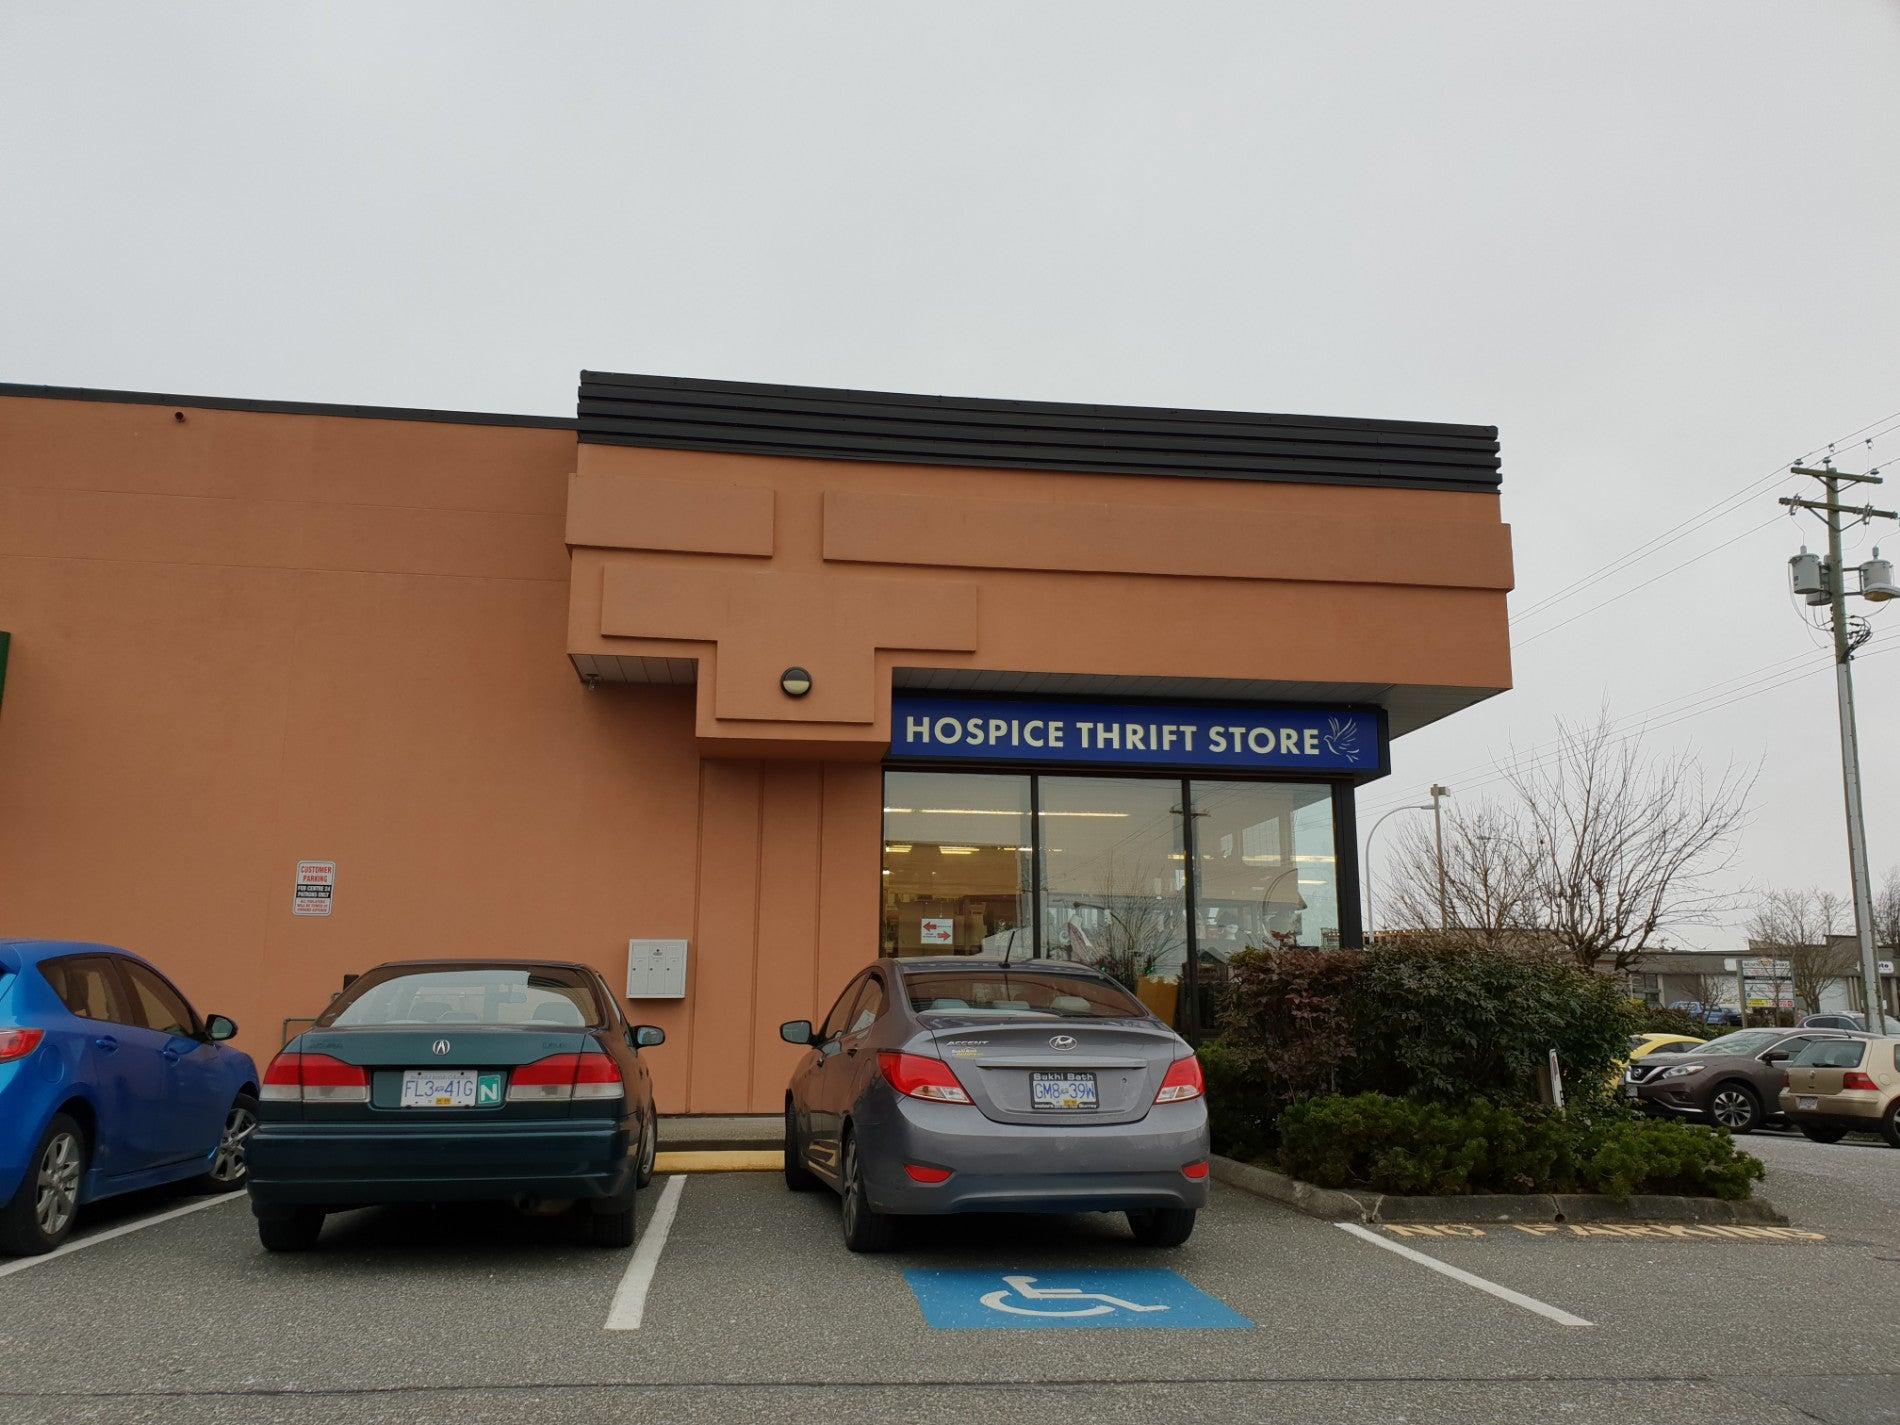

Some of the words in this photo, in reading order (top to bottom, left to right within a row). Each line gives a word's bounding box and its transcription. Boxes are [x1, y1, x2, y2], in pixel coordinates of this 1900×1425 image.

[906, 715, 1064, 748] HOSPICE
[1076, 721, 1197, 752] THRIFT
[1208, 726, 1320, 755] STORE
[301, 866, 332, 874] CUSTOMER
[303, 875, 328, 883] PARKING
[1033, 1072, 1064, 1080] Sukhi
[1067, 1072, 1094, 1080] Bath
[480, 1083, 498, 1102] N
[1384, 1223, 1486, 1236] NO
